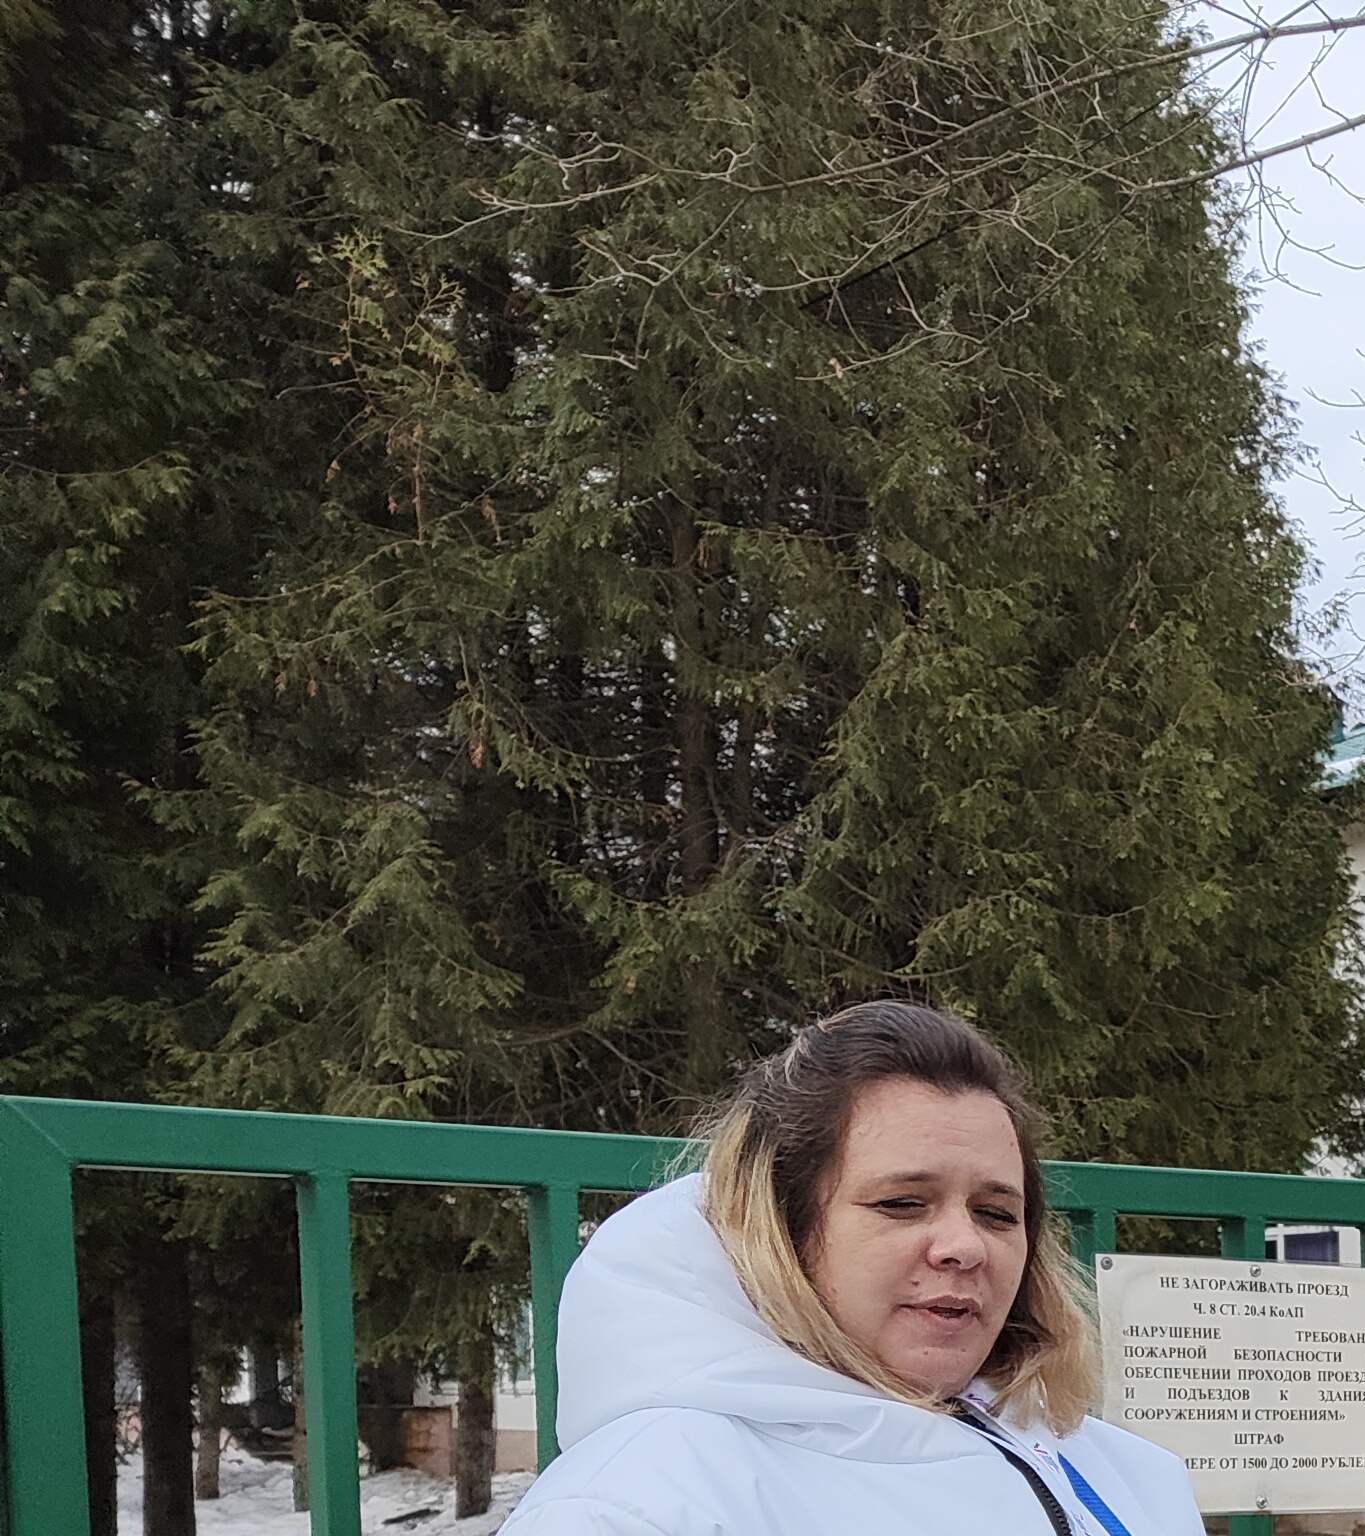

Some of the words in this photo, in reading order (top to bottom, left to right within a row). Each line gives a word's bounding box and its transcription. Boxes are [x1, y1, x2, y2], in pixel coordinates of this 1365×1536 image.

[1159, 1276, 1179, 1289] НЕ
[1182, 1278, 1294, 1295] ЗАГОРАЖИВАТЬ
[1297, 1282, 1350, 1298] ПРОЕЗД
[1193, 1302, 1206, 1315] Ч.
[1209, 1303, 1216, 1316] 8
[1219, 1303, 1241, 1317] СТ.
[1244, 1304, 1266, 1317] 20.4
[1269, 1306, 1304, 1318] КоАП
[1123, 1325, 1222, 1340] «НАРУШЕНИЕ
[1123, 1345, 1207, 1360] ПОЖАРНОЙ
[1233, 1348, 1342, 1363] БЕЗОПАСНОСТИ
[1124, 1366, 1231, 1381] ОБЕСПЕЧЕНИИ
[1237, 1369, 1311, 1383] ПРОХОДОВ
[1124, 1387, 1135, 1399] И
[1167, 1388, 1250, 1402] ПОДЪЕЗДОВ
[1279, 1389, 1289, 1401] К
[1124, 1407, 1238, 1421] СООРУЖЕНИЯМ
[1242, 1409, 1251, 1421] И
[1254, 1409, 1346, 1422] СТРОЕНИЯМ»
[1233, 1433, 1285, 1446] ШТРАФ
[1219, 1457, 1238, 1470] ОТ
[1242, 1457, 1268, 1469] 1500
[1269, 1457, 1289, 1471] ДО
[1292, 1457, 1318, 1469] 2000
